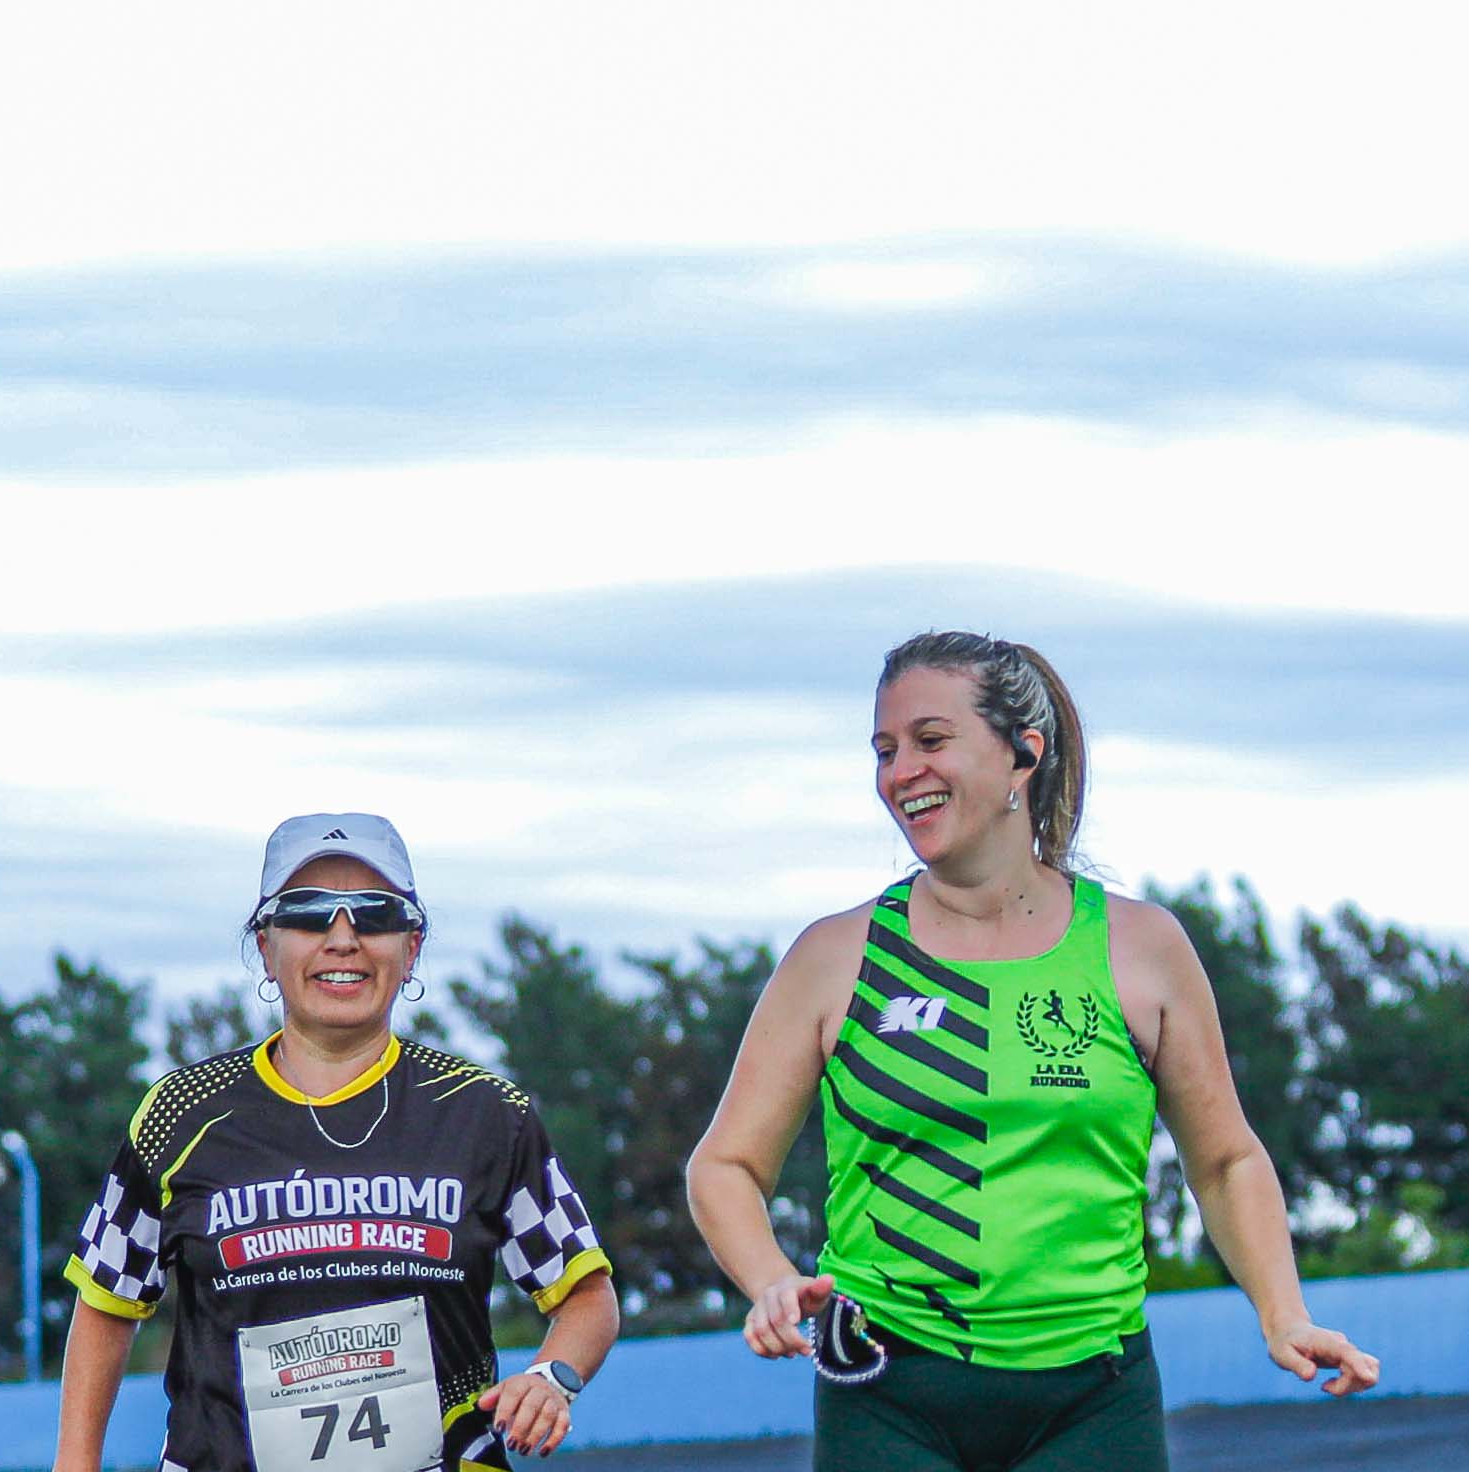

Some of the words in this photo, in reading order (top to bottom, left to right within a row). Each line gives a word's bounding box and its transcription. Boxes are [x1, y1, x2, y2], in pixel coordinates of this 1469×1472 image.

[1030, 1076, 1090, 1089] RUNNING
[1036, 1064, 1055, 1075] LA
[1058, 1064, 1085, 1076] ERA
[206, 1168, 464, 1236] AUTÓDROMO
[241, 1223, 355, 1262] RUNNING
[360, 1222, 427, 1253] RACE
[212, 1277, 227, 1291] La
[227, 1272, 275, 1288] Carrera
[278, 1265, 298, 1282] de
[300, 1264, 323, 1280] los
[326, 1262, 378, 1278] Clubes
[381, 1260, 406, 1277] del
[408, 1262, 465, 1282] Noroeste
[268, 1323, 401, 1369] AUTÓDROMO
[270, 1391, 280, 1399] La
[281, 1386, 309, 1398] Carrera
[310, 1383, 320, 1392] de
[322, 1381, 333, 1390] los
[334, 1377, 361, 1389] Clubes
[361, 1373, 374, 1382] del
[374, 1367, 407, 1381] Noroeste
[290, 1357, 347, 1383] RUNNING
[349, 1352, 382, 1369] RACE
[300, 1394, 391, 1462] 74
